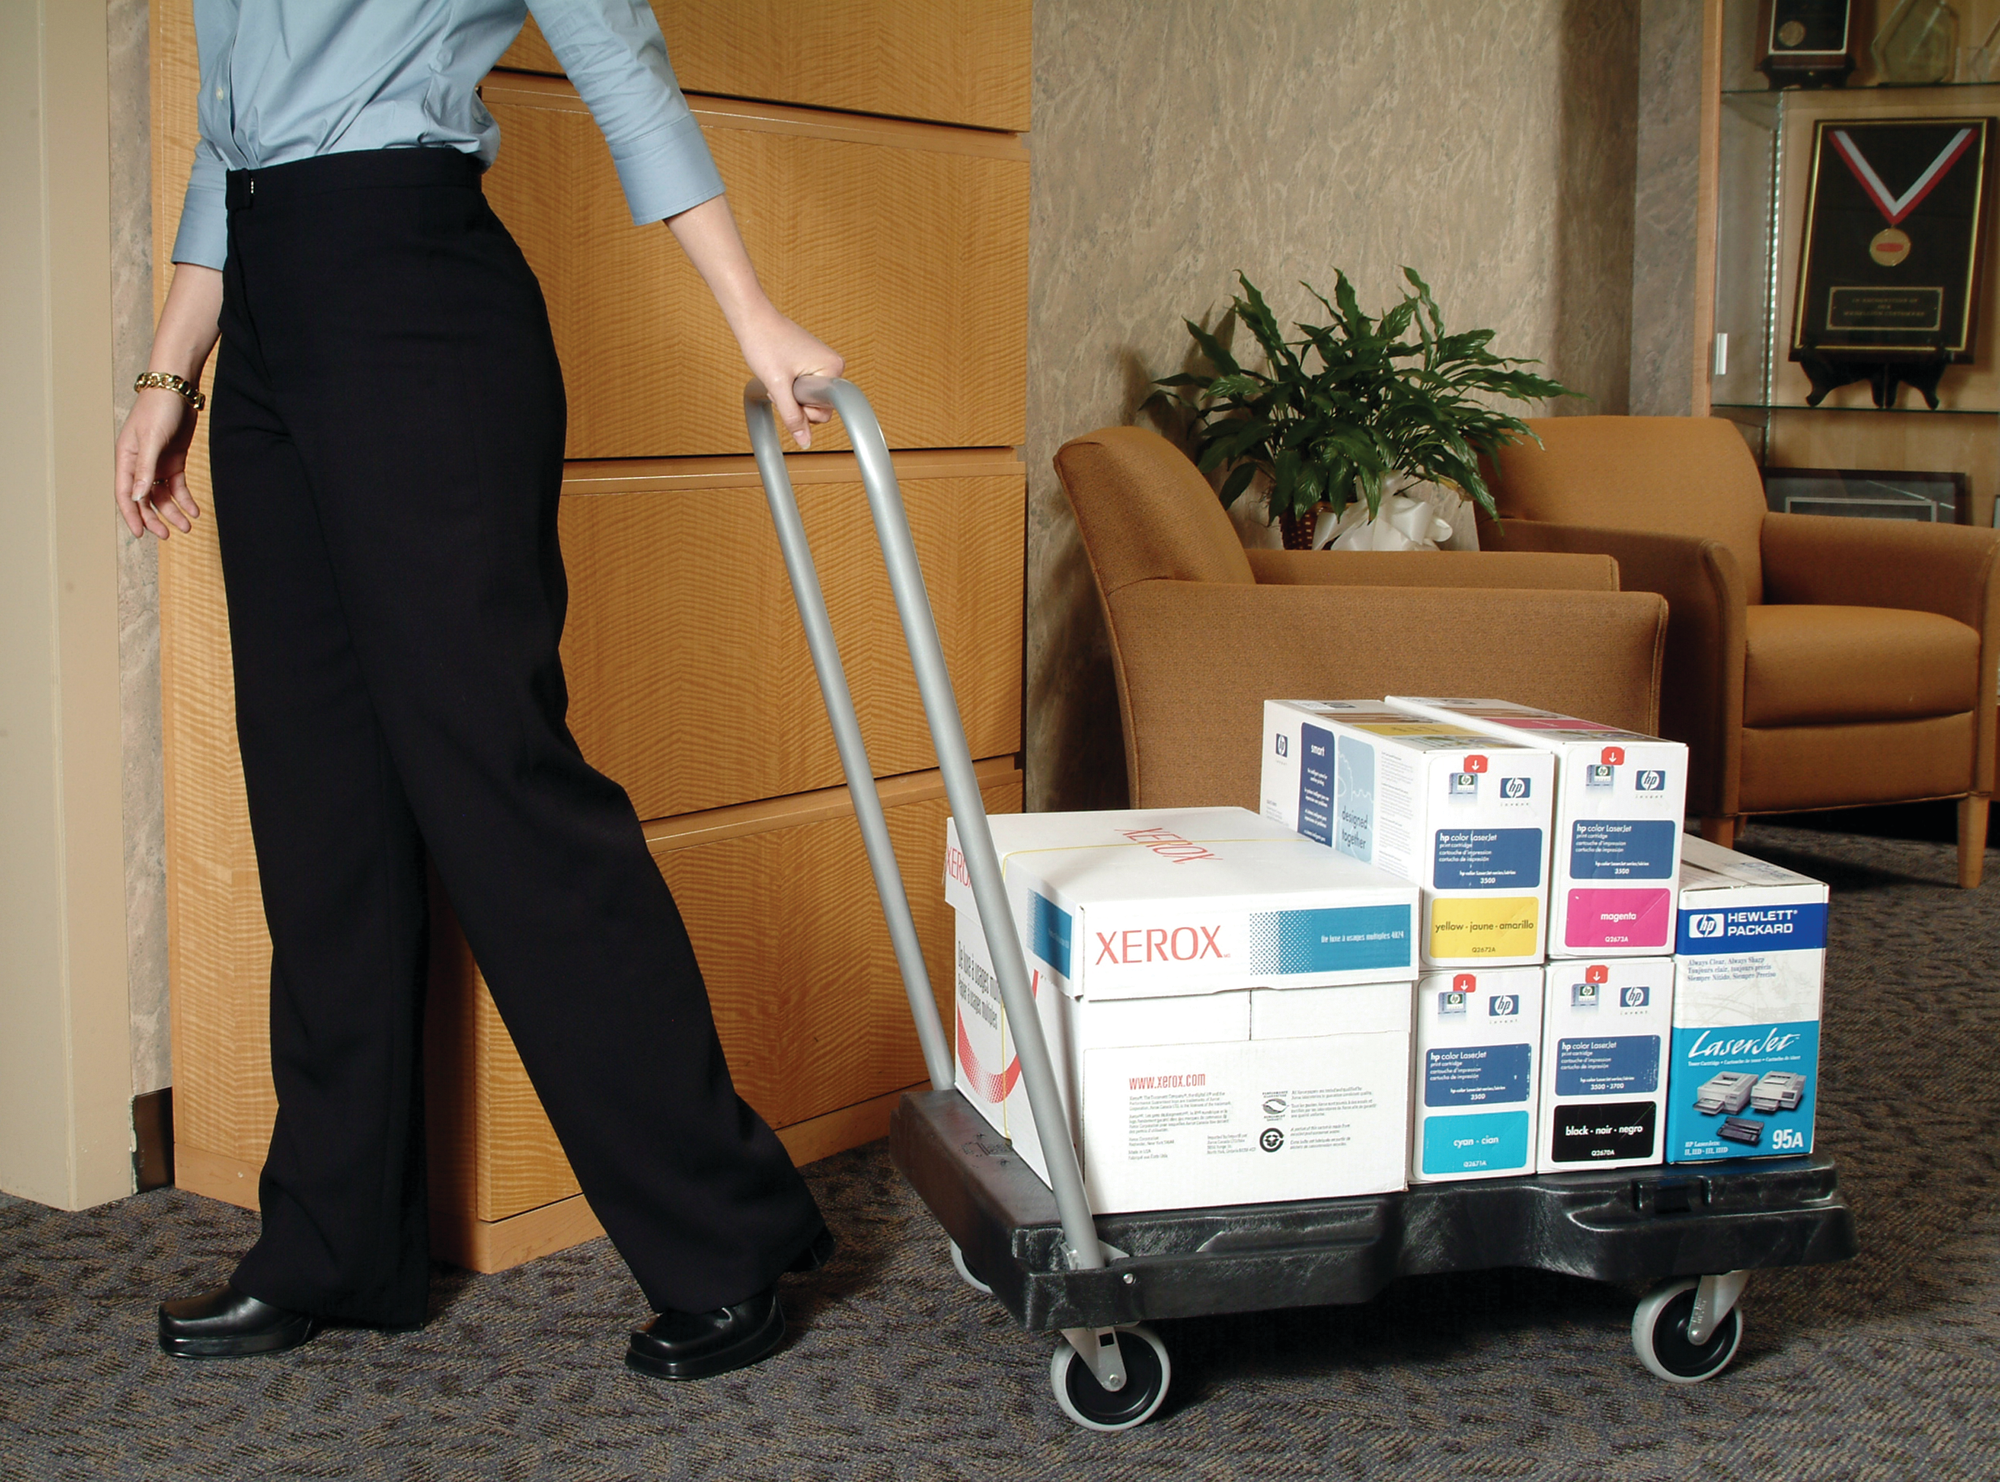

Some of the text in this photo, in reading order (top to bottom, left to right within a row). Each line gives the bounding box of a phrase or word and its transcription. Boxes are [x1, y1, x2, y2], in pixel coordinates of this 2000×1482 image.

[1341, 805, 1369, 830] designed
[1576, 824, 1586, 834] hp
[1587, 824, 1605, 832] color
[1341, 828, 1367, 850] together
[1439, 833, 1450, 843] hp
[1451, 833, 1469, 841] color
[1114, 827, 1223, 865] XEROX
[946, 845, 970, 889] XERO
[1600, 912, 1637, 923] magenta
[1727, 909, 1794, 923] HEWLETT
[1435, 919, 1535, 933] yellow jaune amarillo
[1727, 923, 1794, 937] PACKARD
[1095, 925, 1223, 966] XEROX
[1321, 935, 1329, 943] De
[1346, 934, 1365, 942] usages
[1688, 959, 1708, 967] Always
[1748, 956, 1765, 964] Sharp
[1687, 967, 1713, 975] Toujours
[1731, 965, 1754, 973] toujours
[1687, 975, 1711, 983] Siempre
[1732, 972, 1755, 980] Siempre
[1561, 1042, 1571, 1051] hp
[1572, 1042, 1590, 1050] color
[1687, 1027, 1801, 1058] LaserJet
[1430, 1052, 1440, 1062] hp
[1441, 1052, 1459, 1060] color
[1128, 1073, 1206, 1090] www.xerox.com
[1609, 1082, 1625, 1090] 3700
[1565, 1124, 1643, 1136] black noir negro
[1453, 1134, 1499, 1149] cyan cian
[1772, 1128, 1804, 1150] 95A
